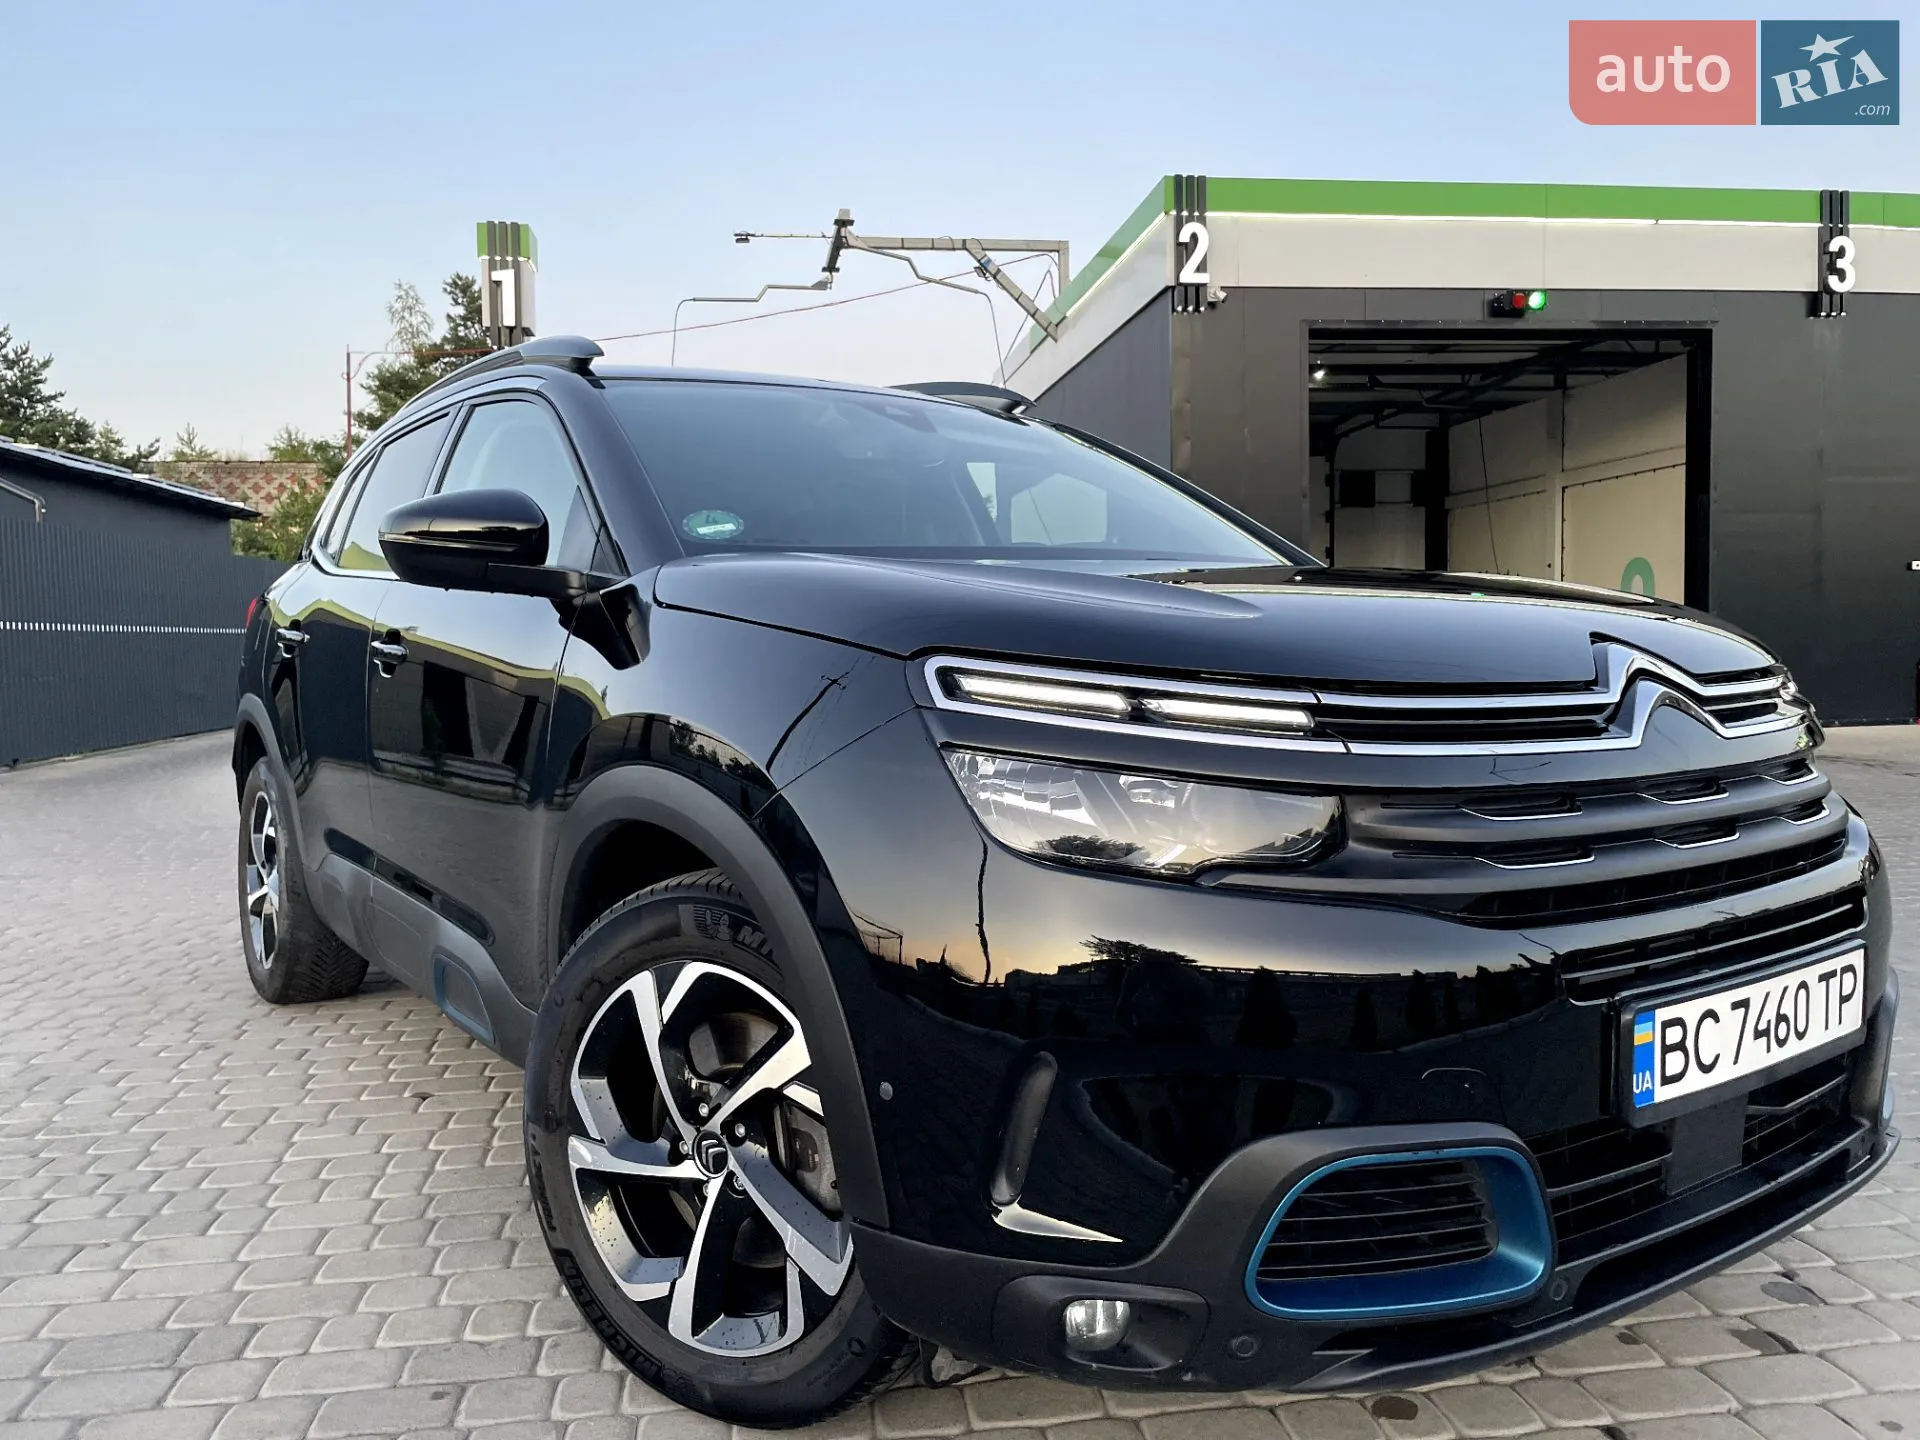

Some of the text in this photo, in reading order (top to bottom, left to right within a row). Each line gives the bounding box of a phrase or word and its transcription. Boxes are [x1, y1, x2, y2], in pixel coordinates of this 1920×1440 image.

[1178, 222, 1210, 283] 2
[1827, 235, 1856, 293] 3
[490, 269, 516, 327] 1
[1660, 963, 1858, 1087] BC 7460 TP
[1633, 1072, 1653, 1094] UA
[556, 1255, 659, 1377] MICHELIN
